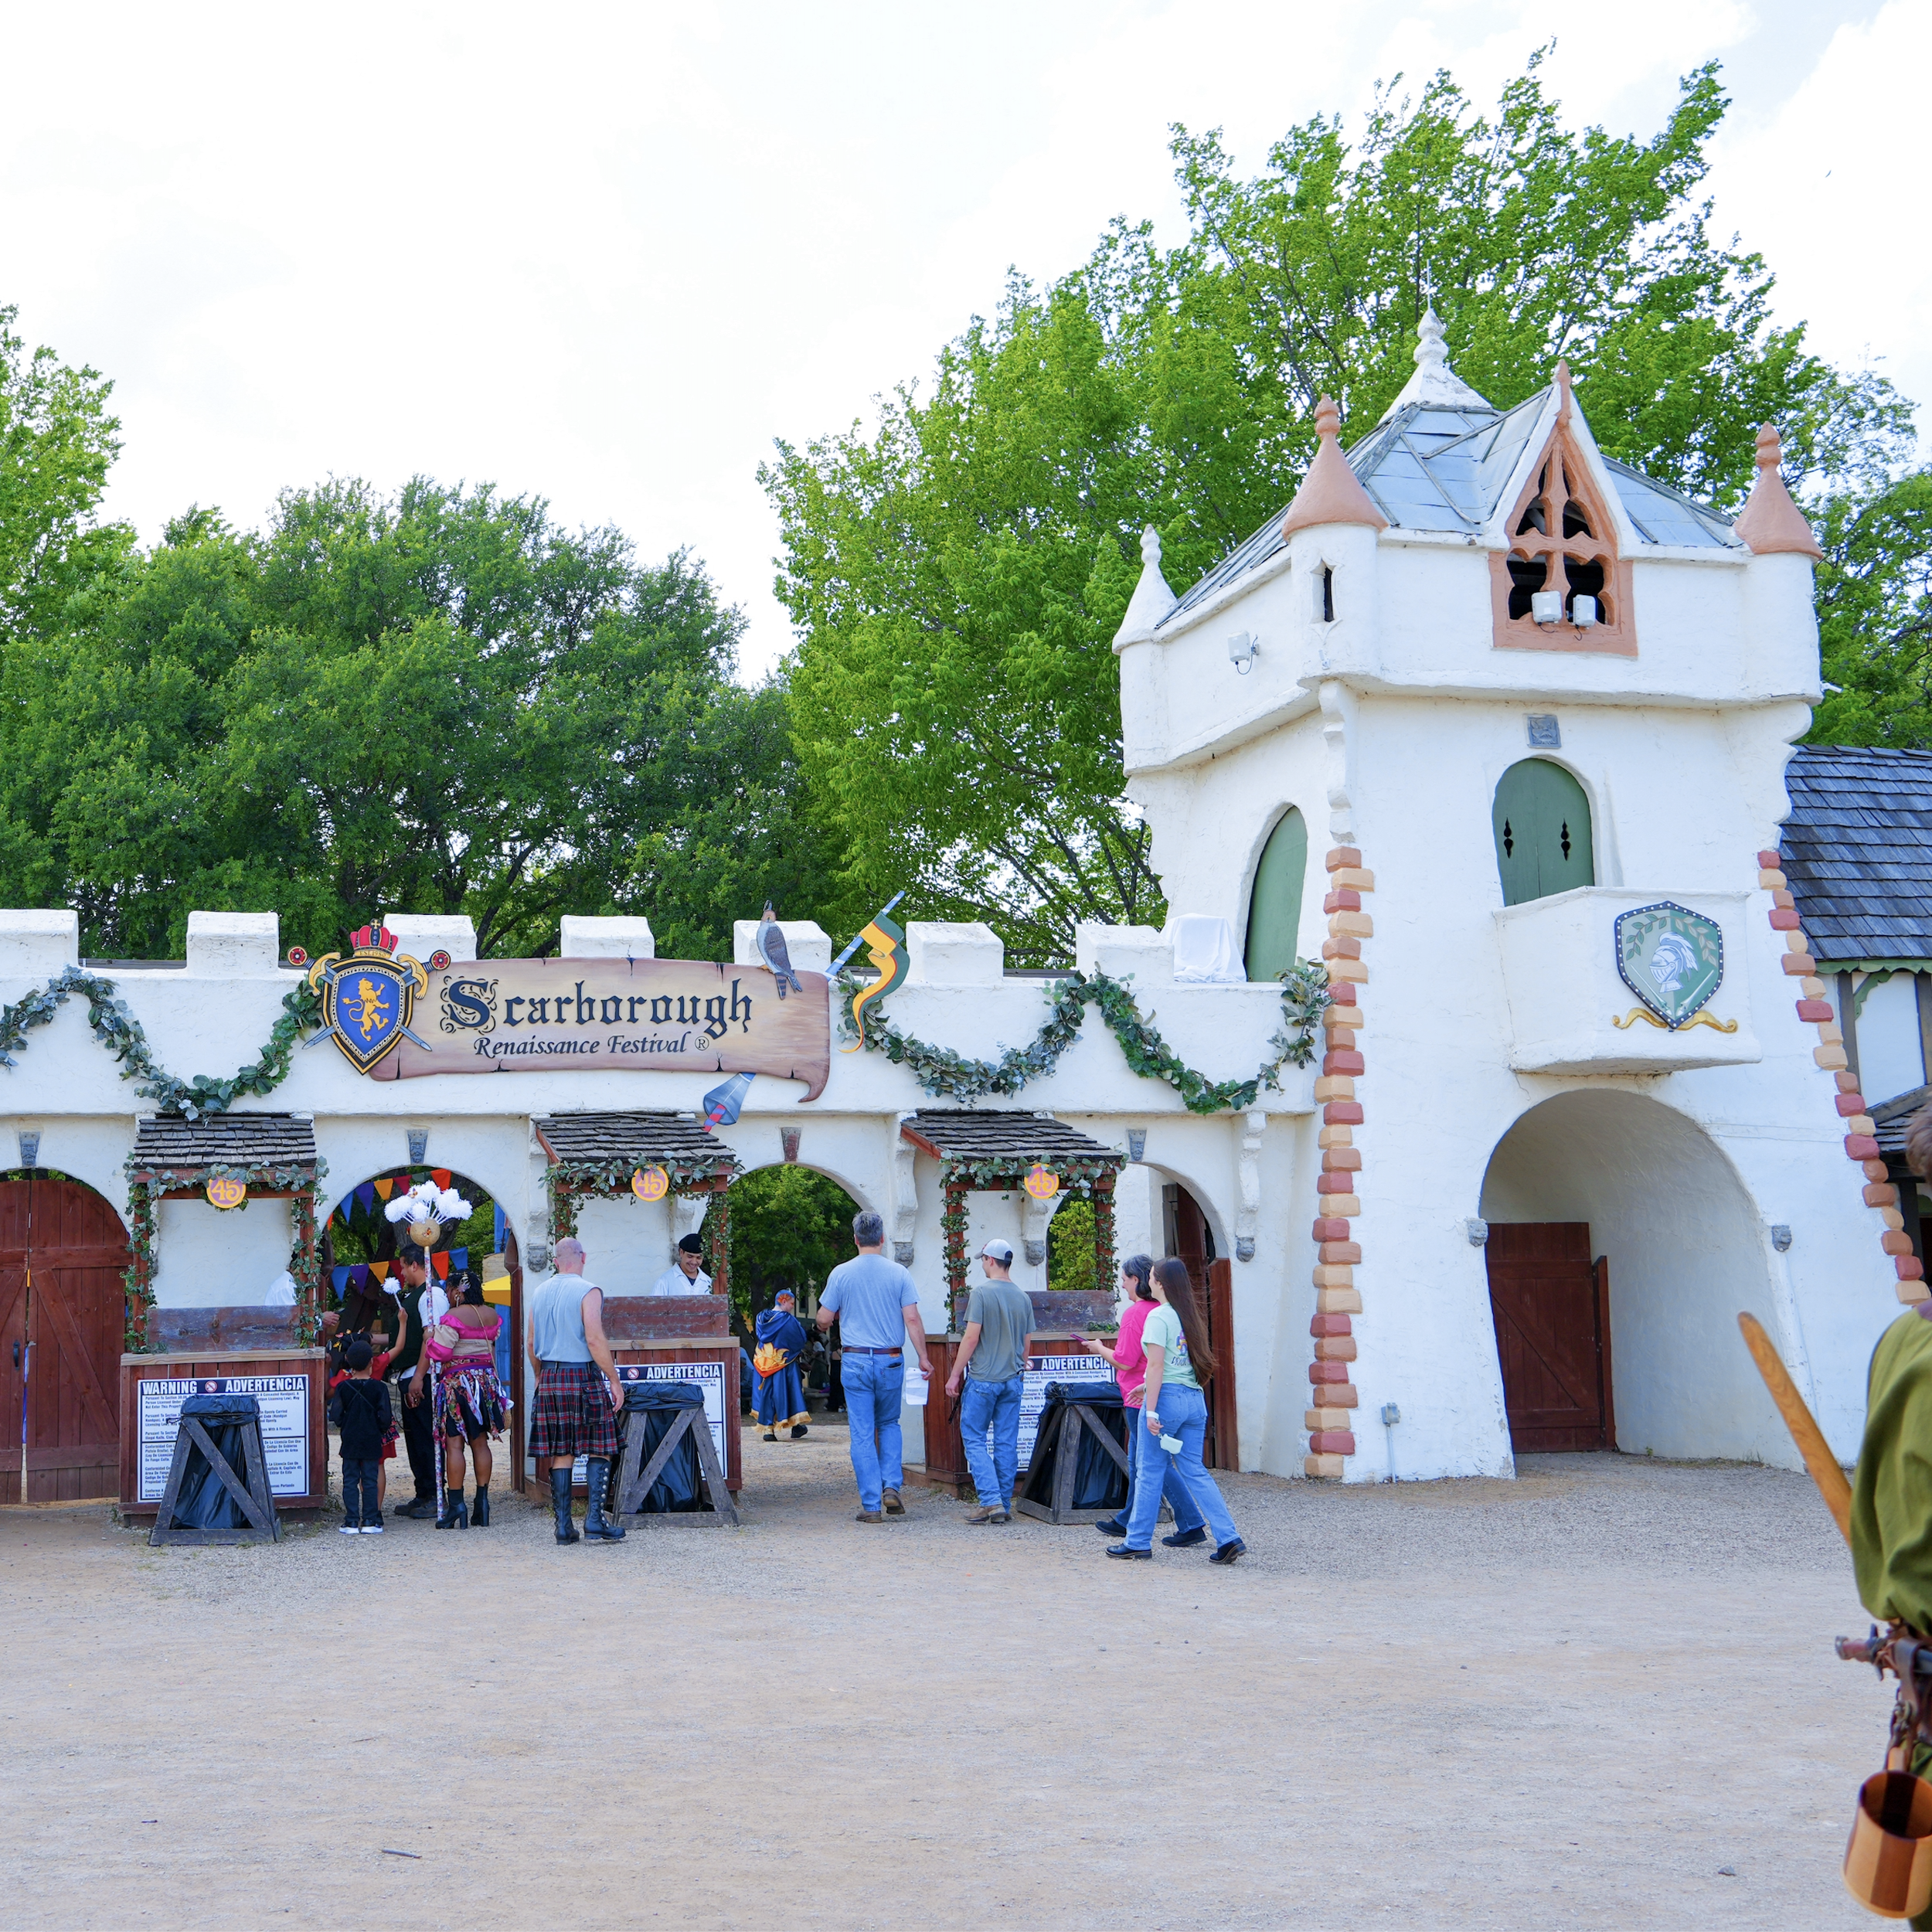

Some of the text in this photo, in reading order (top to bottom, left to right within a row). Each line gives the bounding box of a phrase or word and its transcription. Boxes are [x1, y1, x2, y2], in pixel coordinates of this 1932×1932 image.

[443, 977, 752, 1040] Scarborough
[474, 1035, 600, 1059] Renaissance
[607, 1031, 692, 1053] Festival
[211, 1179, 240, 1202] 45
[636, 1172, 665, 1196] 45
[1029, 1171, 1055, 1193] 45
[647, 1366, 720, 1379] ADVERTENCIA
[1041, 1357, 1111, 1371] ADVERTENCIA
[142, 1377, 304, 1395] WARNING ADVERTENCIA
